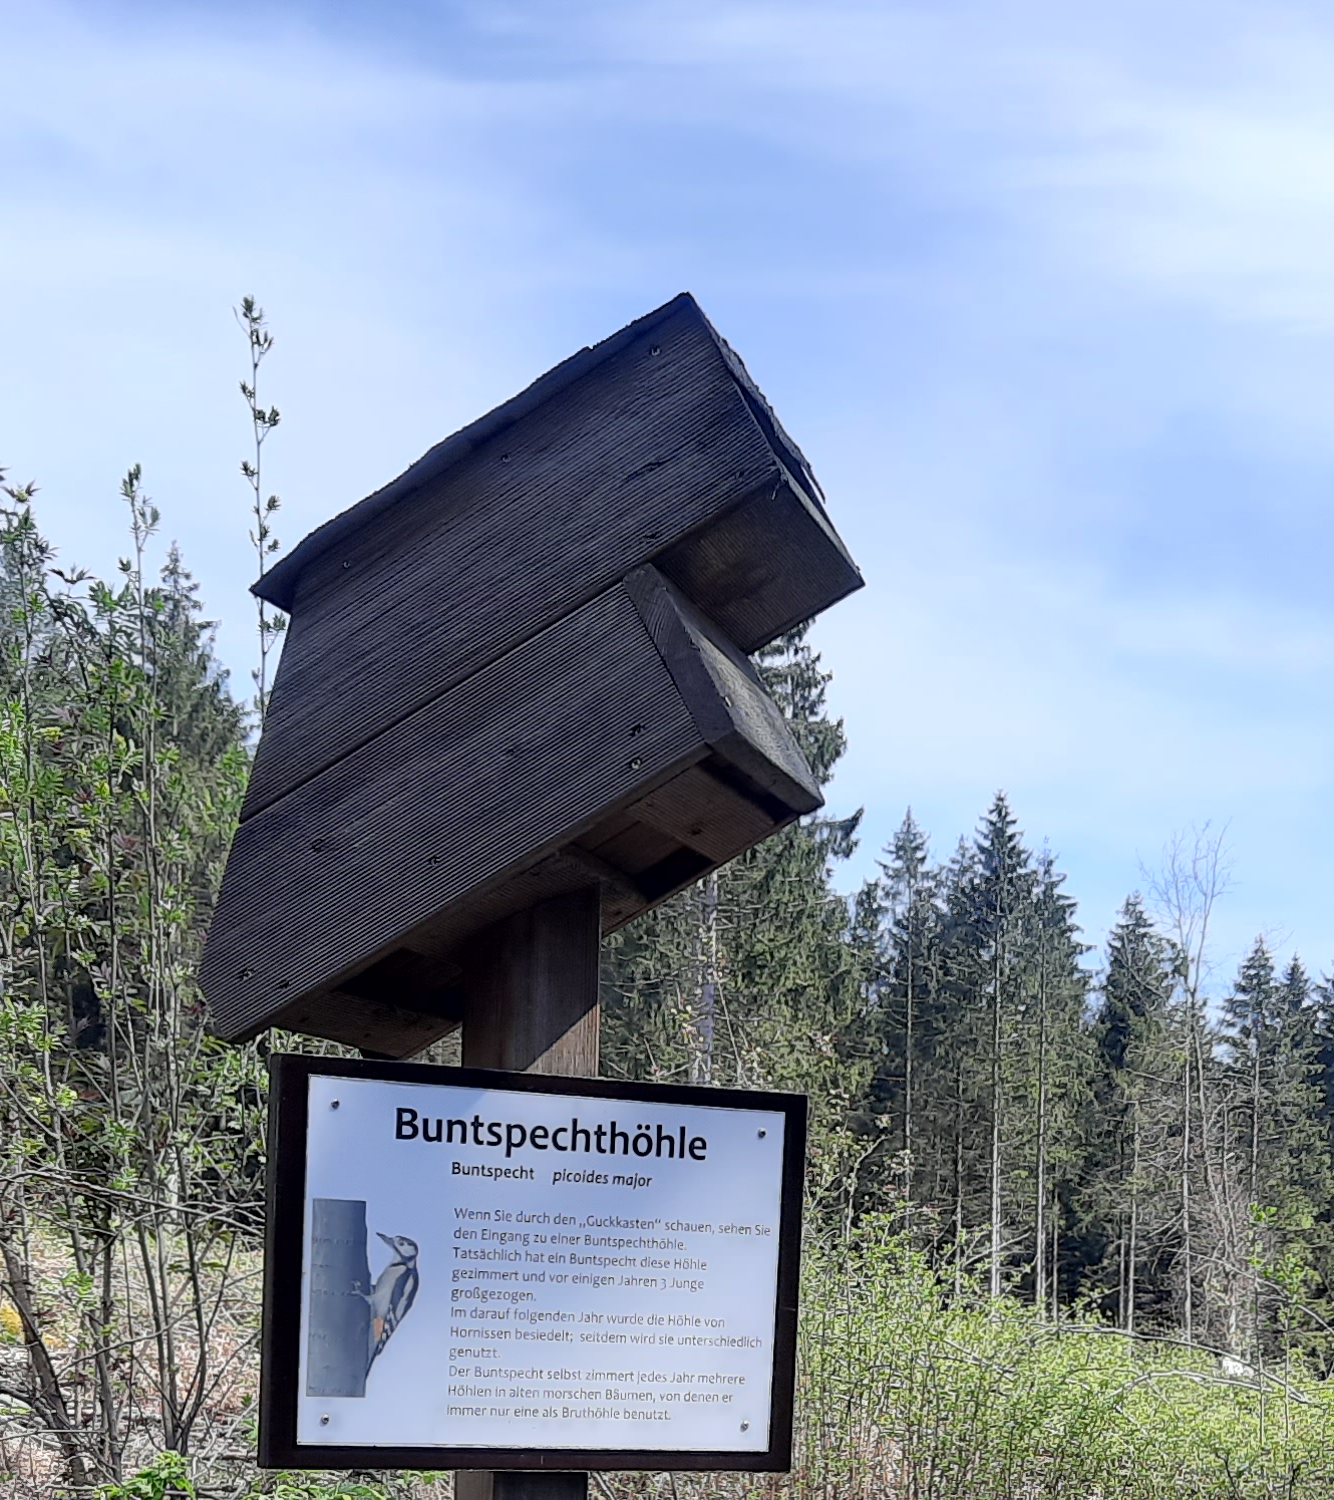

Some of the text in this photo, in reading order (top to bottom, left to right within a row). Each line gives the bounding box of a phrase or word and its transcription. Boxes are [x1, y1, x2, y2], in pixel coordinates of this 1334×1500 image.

[394, 1107, 708, 1162] Buntspechthöhle
[451, 1161, 652, 1189] Buntspecht picoides major
[454, 1207, 491, 1221] Wenn
[494, 1210, 512, 1222] Sie
[516, 1211, 550, 1224] durch
[553, 1213, 576, 1225] den
[665, 1220, 715, 1235] schauen,
[718, 1223, 752, 1235] sehen
[755, 1225, 771, 1236] Sie
[453, 1227, 687, 1250] den Eingang zu einer Buntspechthöhle.
[452, 1247, 707, 1270] Tatsächlich hat ein Buntspecht diese Höhle
[452, 1268, 705, 1292] gezimmert und vor einigen Jahren 3 Junge
[451, 1286, 537, 1304] großgezogen.
[451, 1307, 725, 1328] Im darauf folgenden Jahr wurde die Höhle von
[450, 1326, 762, 1348] Hornissen besiedelt; seitdem wird sie unterschiedlich
[449, 1348, 501, 1361] genutzt.
[449, 1365, 746, 1385] Der Buntspecht selbst zimmert jedes Jahr mehrere
[448, 1385, 733, 1403] Höhlen in alten morschen Bäumen, von denen er
[447, 1404, 671, 1421] immer nur eine als Bruthöhle benutzt.
